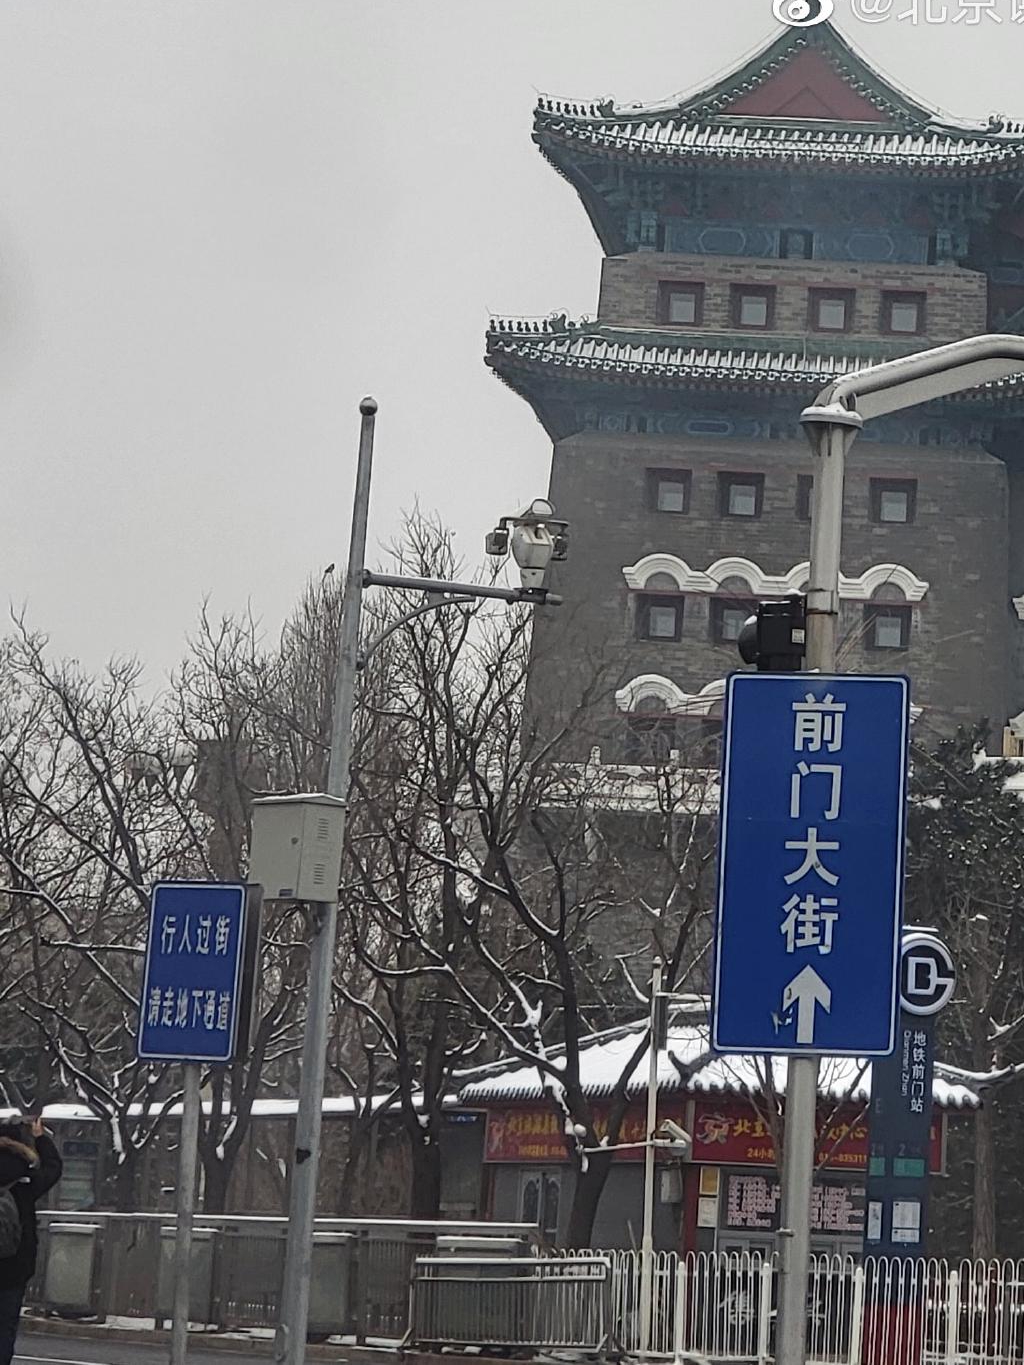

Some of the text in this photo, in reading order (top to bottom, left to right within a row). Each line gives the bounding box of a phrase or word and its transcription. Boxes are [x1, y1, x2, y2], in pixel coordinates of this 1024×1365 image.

[780, 692, 847, 955] 前门大街
[160, 914, 231, 956] 行人过街
[147, 986, 231, 1030] 请走地下通道
[910, 1030, 926, 1114] 地铁前门站
